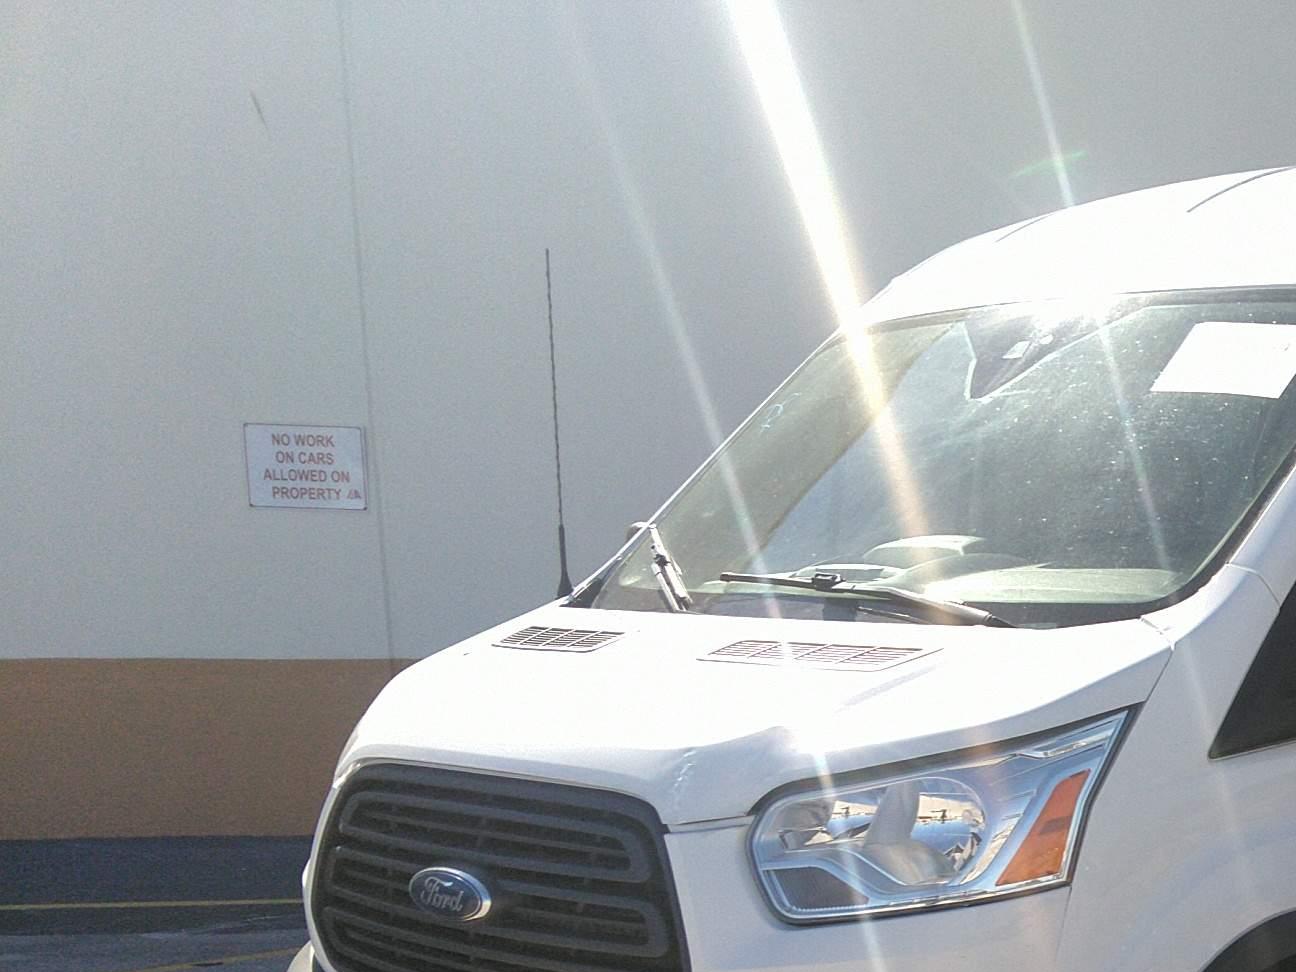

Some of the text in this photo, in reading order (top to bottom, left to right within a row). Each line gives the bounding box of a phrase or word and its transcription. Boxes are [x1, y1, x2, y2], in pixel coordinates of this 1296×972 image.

[272, 433, 335, 448] NO WORK
[275, 451, 334, 465] ON CARS
[264, 468, 350, 483] ALLOWED ON
[272, 486, 341, 500] PROPERTY
[420, 876, 465, 912] Ford
